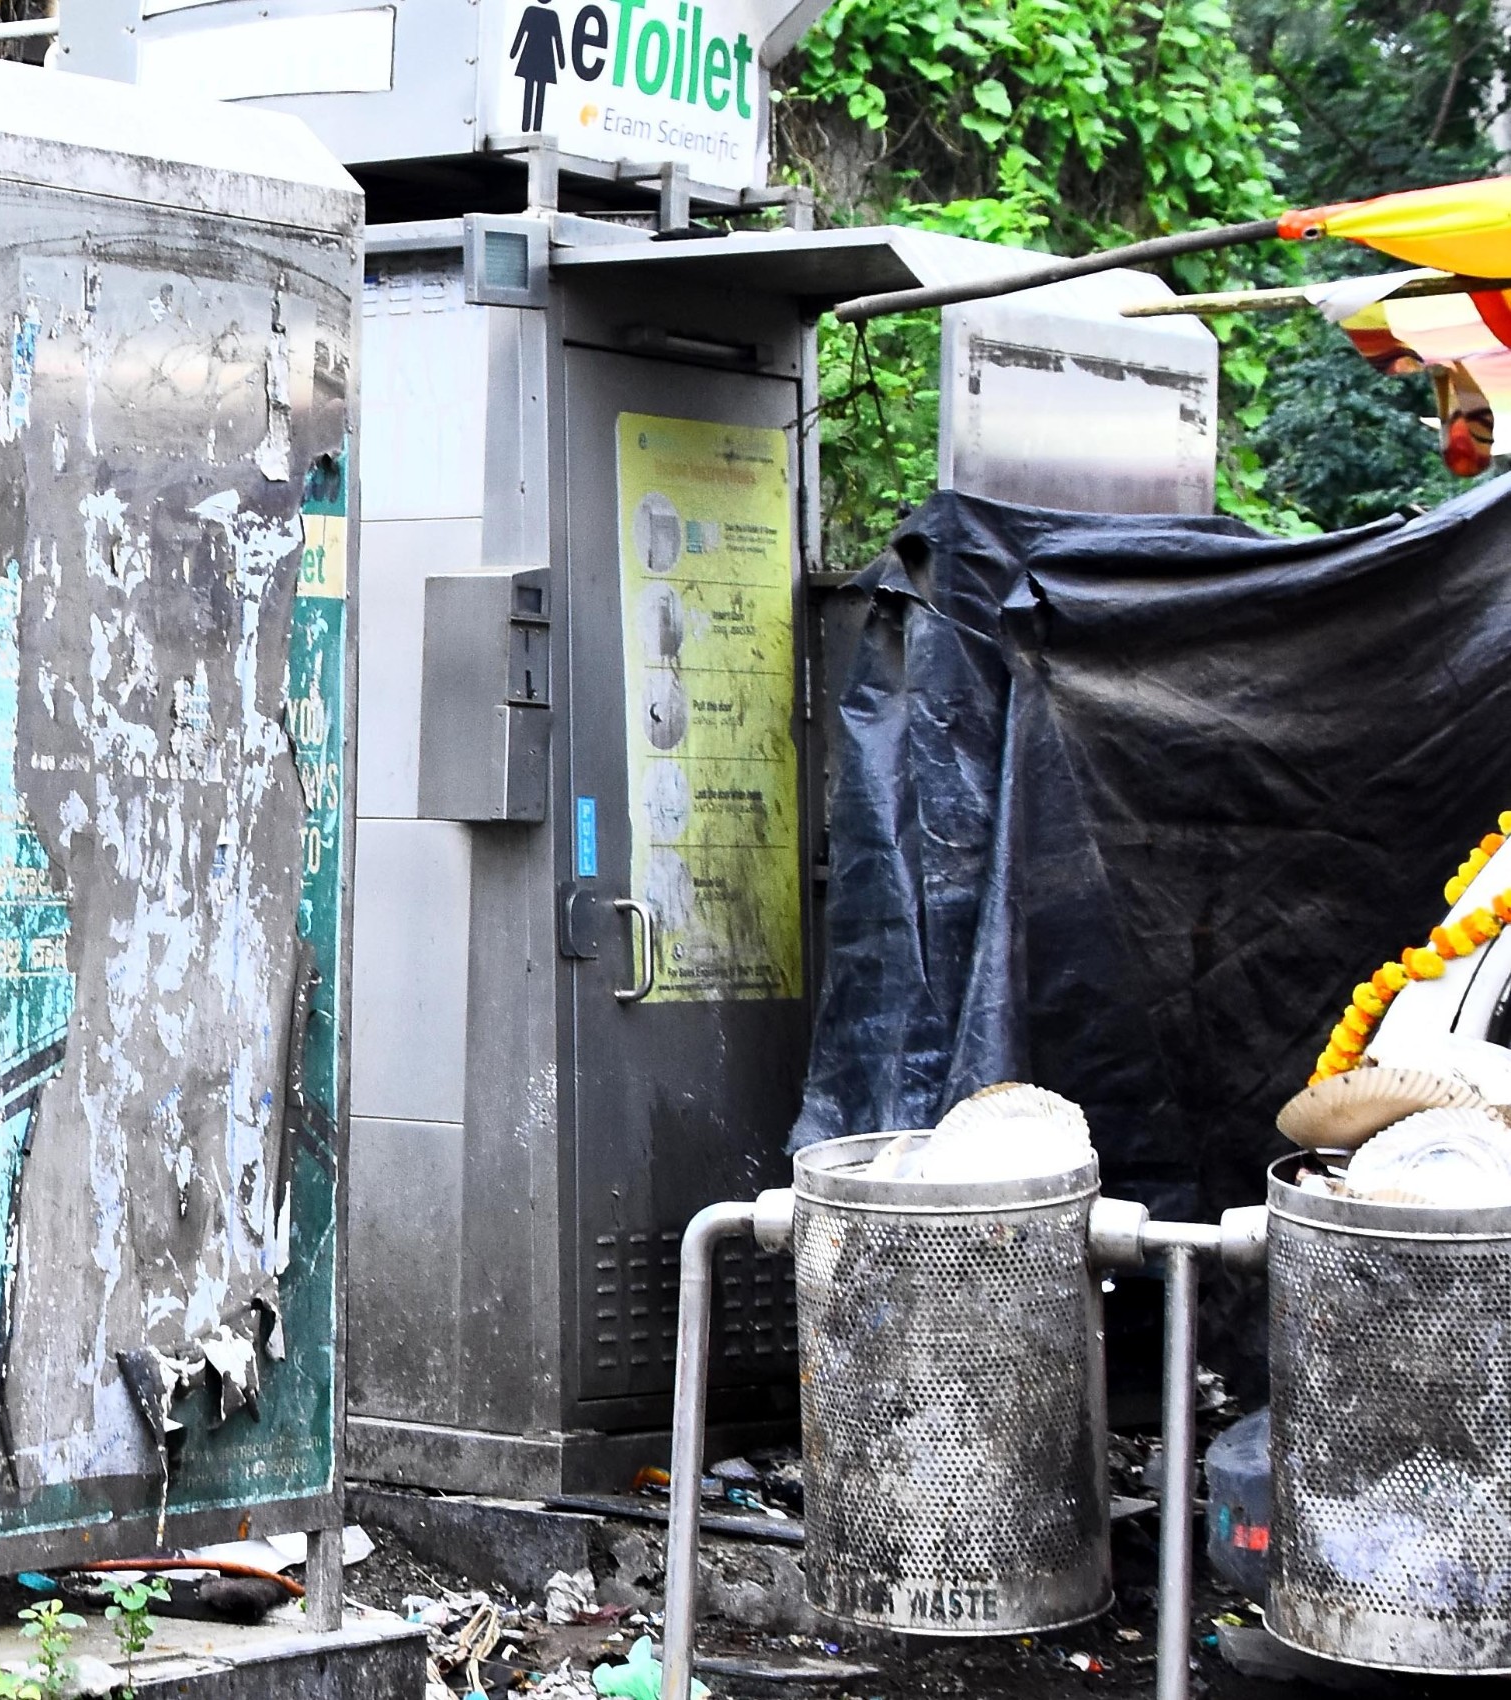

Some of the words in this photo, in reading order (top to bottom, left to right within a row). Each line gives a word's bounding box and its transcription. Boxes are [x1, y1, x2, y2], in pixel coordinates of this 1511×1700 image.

[571, 0, 753, 119] eToilet
[603, 107, 651, 141] Eram
[659, 119, 740, 161] Scientific
[910, 1588, 998, 1621] WASTE
